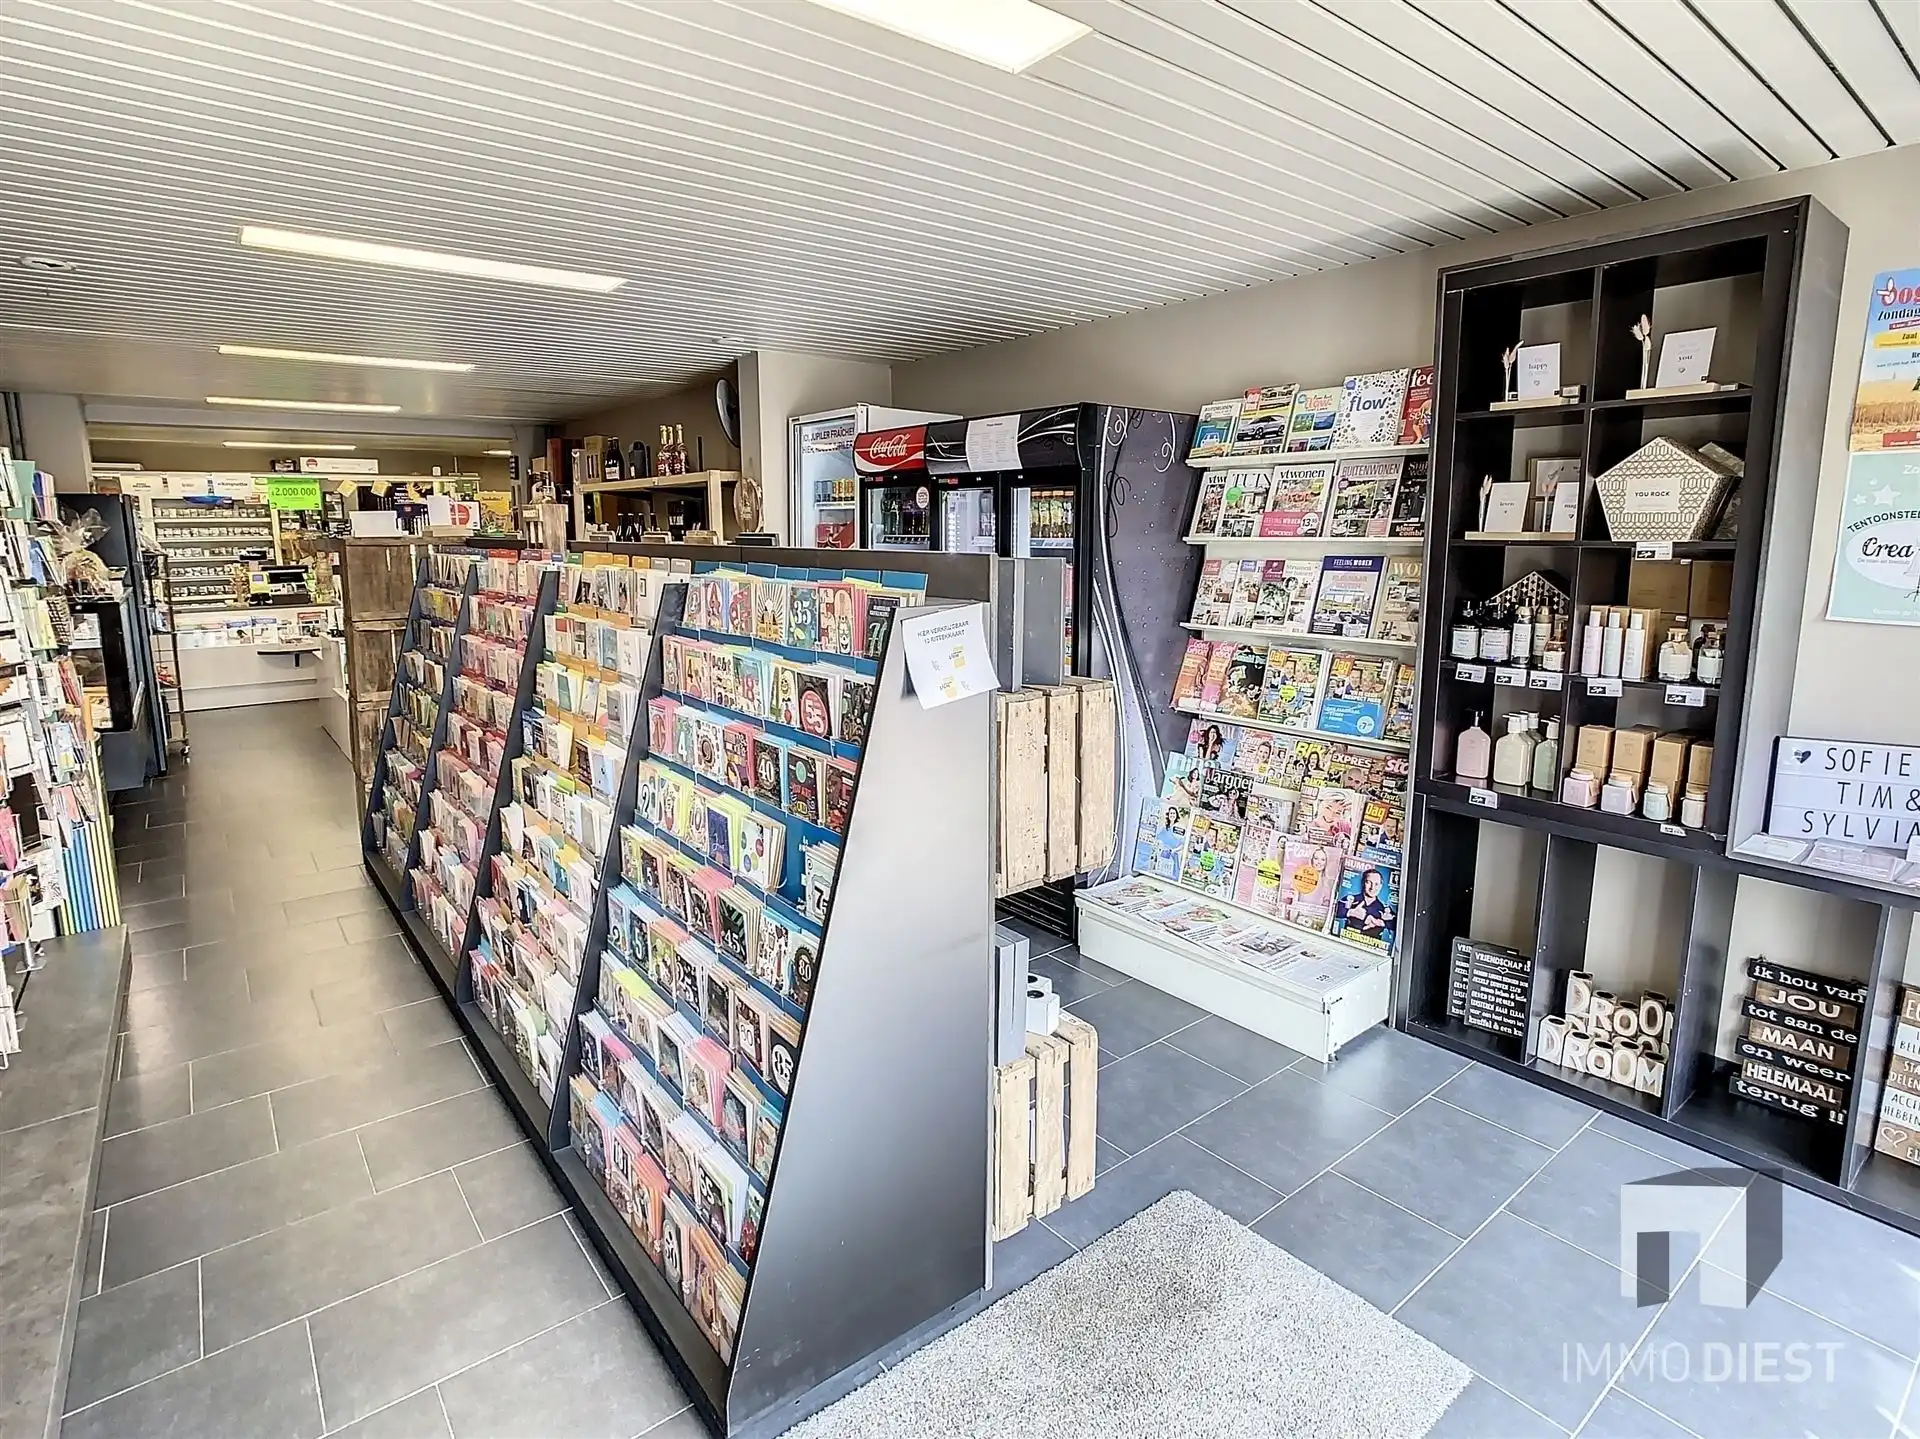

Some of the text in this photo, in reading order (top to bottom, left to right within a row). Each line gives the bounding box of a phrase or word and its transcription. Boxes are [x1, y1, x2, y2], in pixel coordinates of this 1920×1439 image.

[1350, 394, 1388, 412] flow
[869, 433, 911, 459] Coca-Cola
[1280, 468, 1325, 479] vtwonen
[1862, 536, 1914, 558] Crea
[794, 600, 811, 624] 35
[1333, 753, 1372, 768] EXPRES
[1825, 747, 1912, 777] SOFIE
[1837, 781, 1920, 812] TIM &
[724, 930, 741, 953] 45
[1475, 952, 1523, 971] VRIENDSCHAP
[1753, 965, 1866, 1004] ik hou van
[1768, 990, 1841, 1019] JOU
[1747, 1003, 1859, 1044] tot aan de
[1761, 1026, 1835, 1061] MAAN
[1538, 1022, 1664, 1098] DROOM
[1741, 1043, 1852, 1082] en weer
[1746, 1062, 1838, 1104] HELEMAAL
[1735, 1079, 1820, 1118] terug
